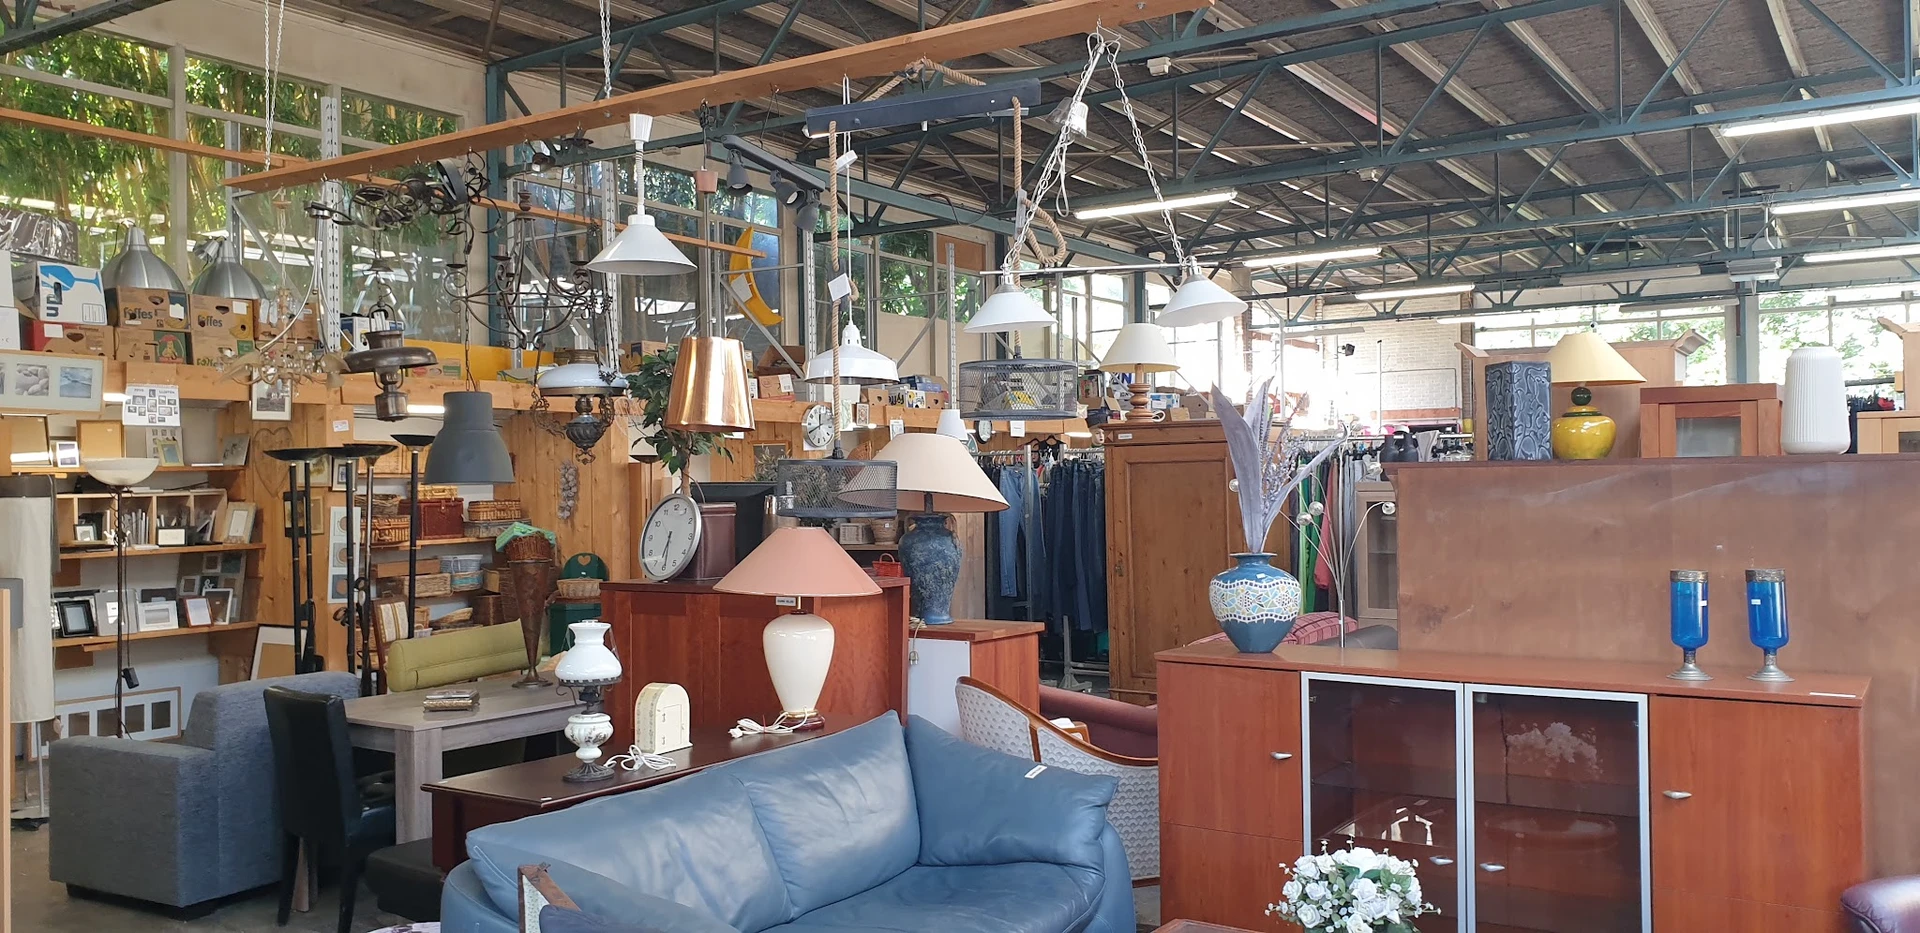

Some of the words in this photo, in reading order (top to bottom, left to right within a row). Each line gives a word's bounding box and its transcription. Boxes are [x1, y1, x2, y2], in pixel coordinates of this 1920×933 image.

[673, 503, 680, 511] 12
[654, 520, 661, 528] 10
[688, 517, 693, 525] 2
[648, 534, 653, 542] 9
[688, 532, 693, 541] 3
[648, 549, 653, 557] 8
[672, 559, 677, 567] 5
